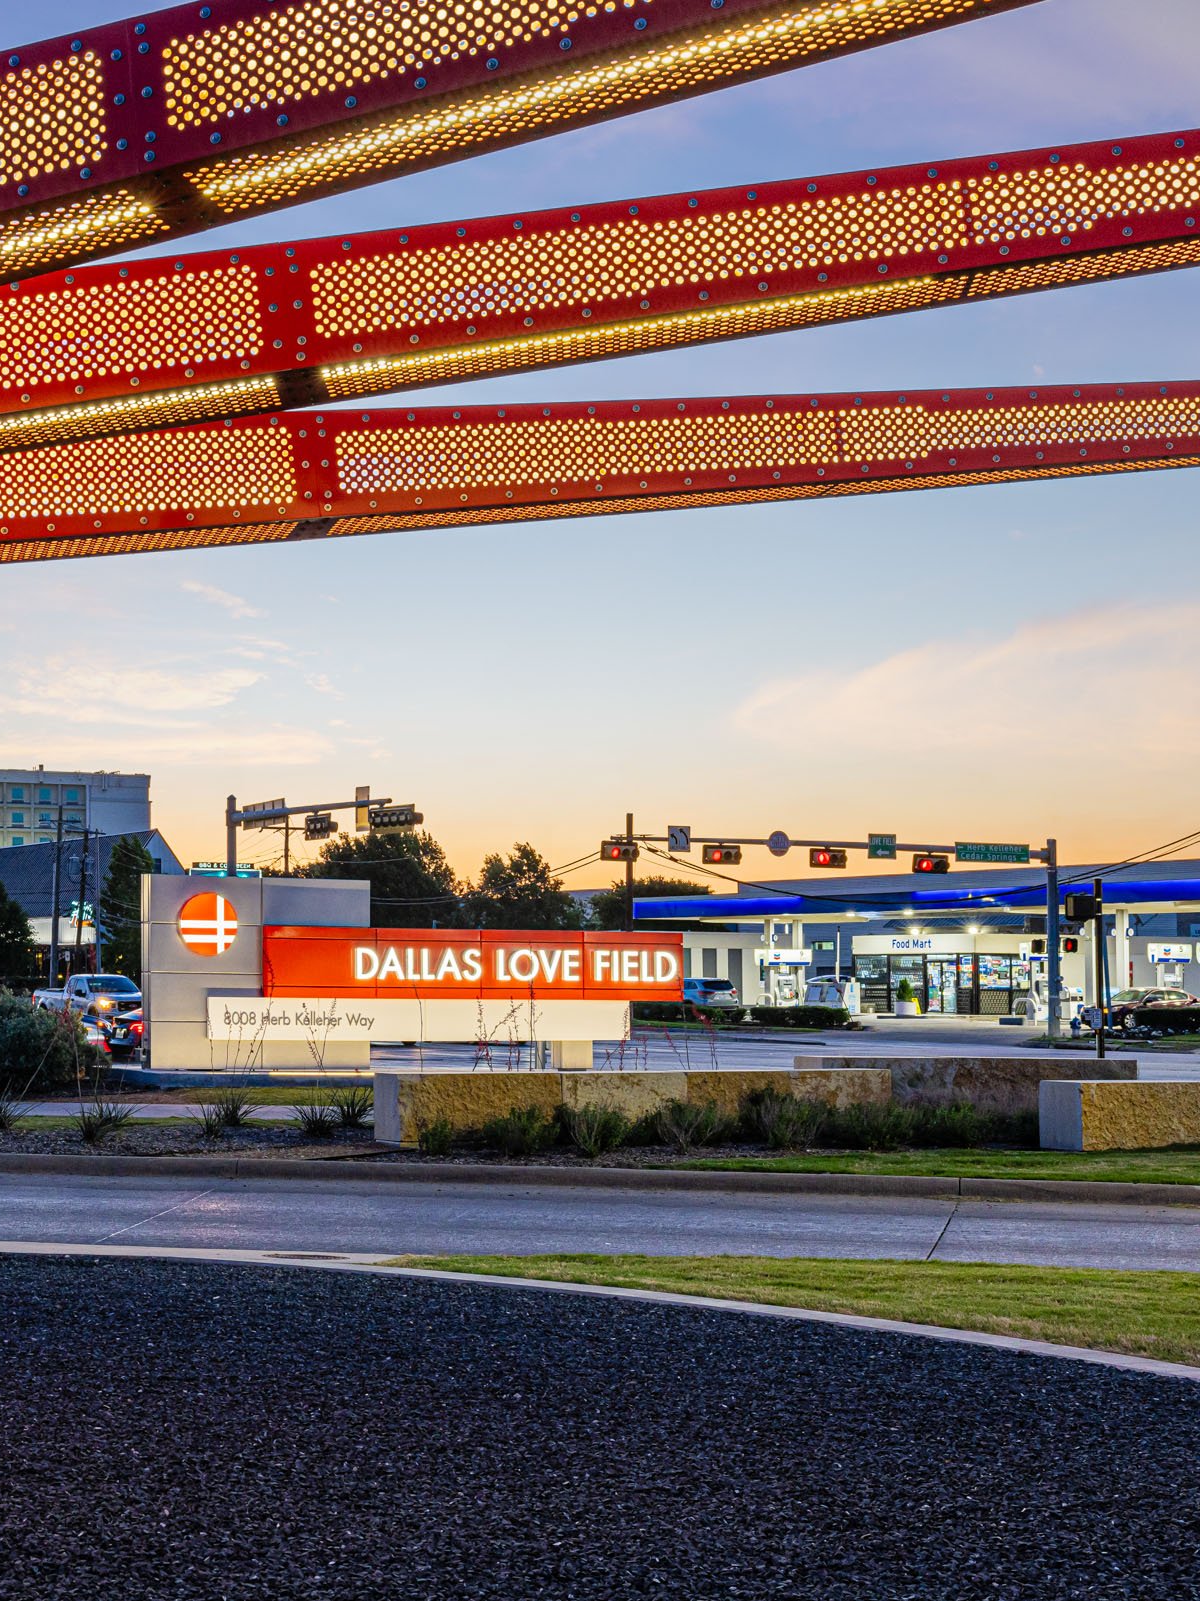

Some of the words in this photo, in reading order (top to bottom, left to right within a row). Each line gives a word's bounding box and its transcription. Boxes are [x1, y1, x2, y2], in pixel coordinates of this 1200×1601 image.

[967, 844, 986, 852] Herb
[960, 852, 984, 861] Cedar
[987, 853, 1017, 862] Springs
[892, 939, 910, 949] Food
[912, 939, 932, 949] Mart
[353, 946, 483, 982] DALLAS
[495, 948, 580, 983] LOVE
[594, 950, 678, 984] FIELD
[223, 1011, 257, 1026] 8008
[261, 1010, 291, 1026] Herb
[295, 1011, 342, 1027] Kelleher
[345, 1012, 375, 1031] Way
